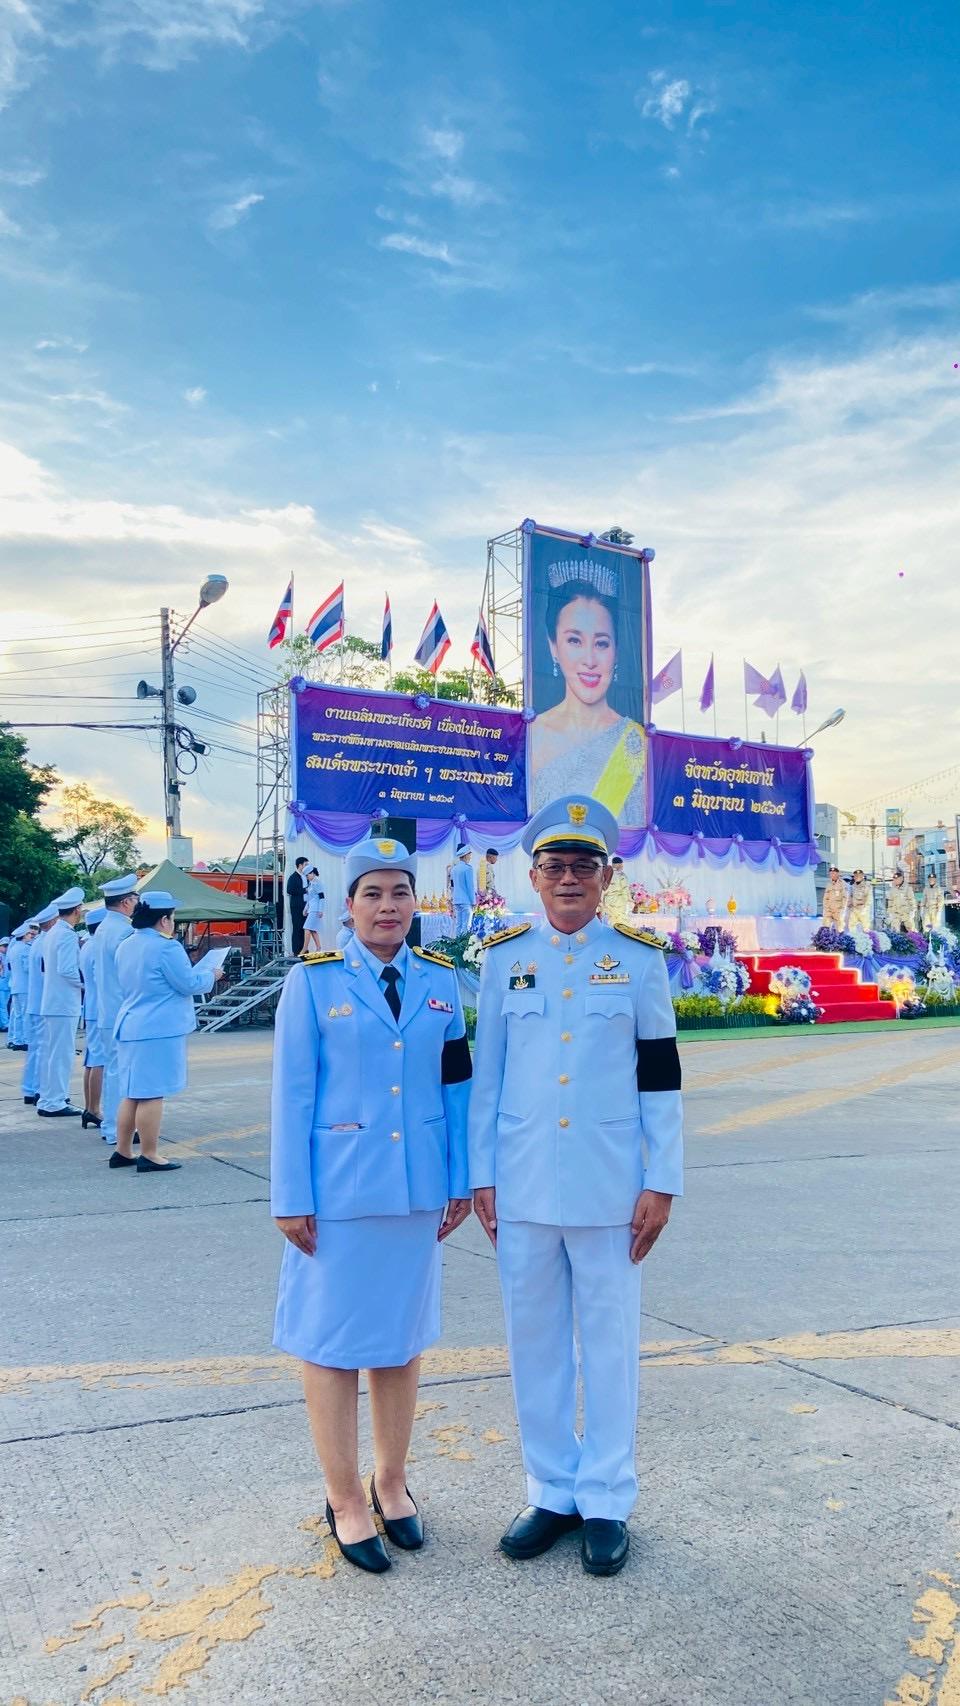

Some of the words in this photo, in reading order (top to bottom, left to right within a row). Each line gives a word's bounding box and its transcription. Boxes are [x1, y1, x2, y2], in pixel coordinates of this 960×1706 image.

[325, 707, 432, 731] งานเฉลิมพระเกียรติ
[437, 716, 503, 739] เนื่องในโอกาส
[305, 751, 418, 777] สมเด็จพระนางเจ้า
[439, 768, 513, 787] พระบรมราชินี
[494, 753, 509, 762] รอบ
[685, 758, 775, 789] จังหวัดอุทัยธานี
[390, 787, 425, 802] มิถุนายน
[673, 795, 684, 807] ๓
[692, 788, 745, 816] มิถุนายน
[751, 799, 786, 815] ๒๕๖๙
